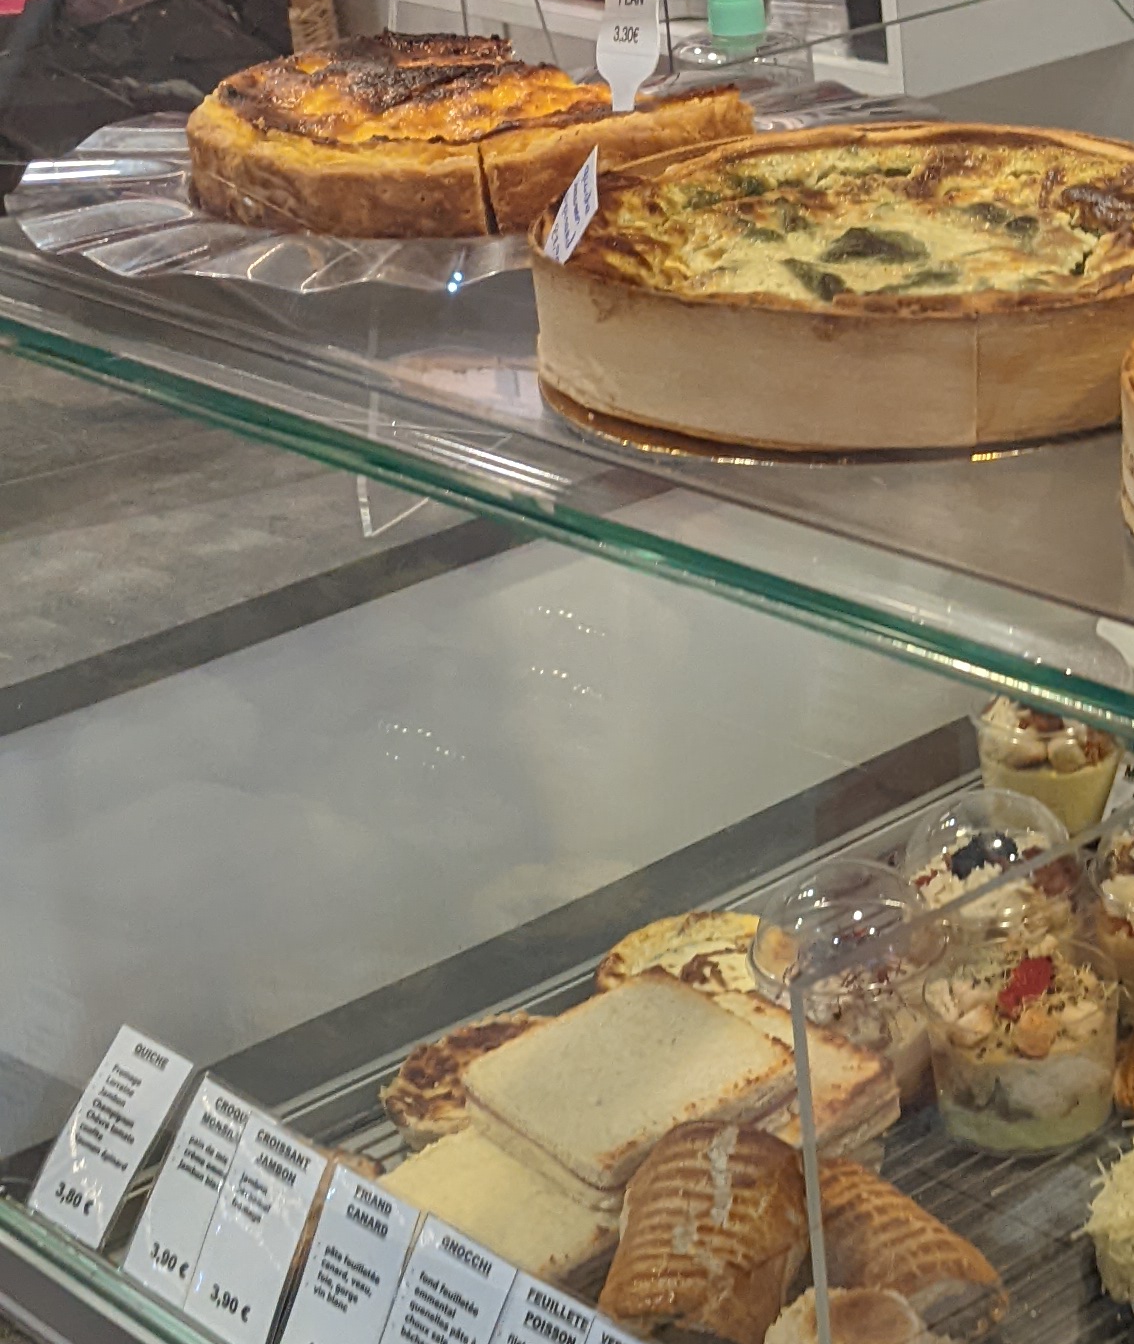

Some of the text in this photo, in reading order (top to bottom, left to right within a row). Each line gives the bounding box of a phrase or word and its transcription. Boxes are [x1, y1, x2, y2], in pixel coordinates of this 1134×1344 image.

[132, 1041, 169, 1070] QUICHE
[213, 1095, 250, 1126] CROQU
[255, 1126, 311, 1171] CROISSANT
[255, 1150, 297, 1186] JAMBON
[52, 1180, 95, 1216] 3,80 €
[353, 1184, 393, 1216] FRIAND
[345, 1202, 389, 1237] CANARD
[176, 1260, 190, 1279] €
[440, 1233, 492, 1276] GNOCCHI
[418, 1269, 439, 1291] fond
[208, 1282, 251, 1323] 3,90 €
[312, 1283, 349, 1313] vin blanc
[407, 1297, 450, 1333] quenelles
[413, 1284, 457, 1320] emmental
[526, 1286, 589, 1333] FEUILLETE
[403, 1312, 430, 1336] choux
